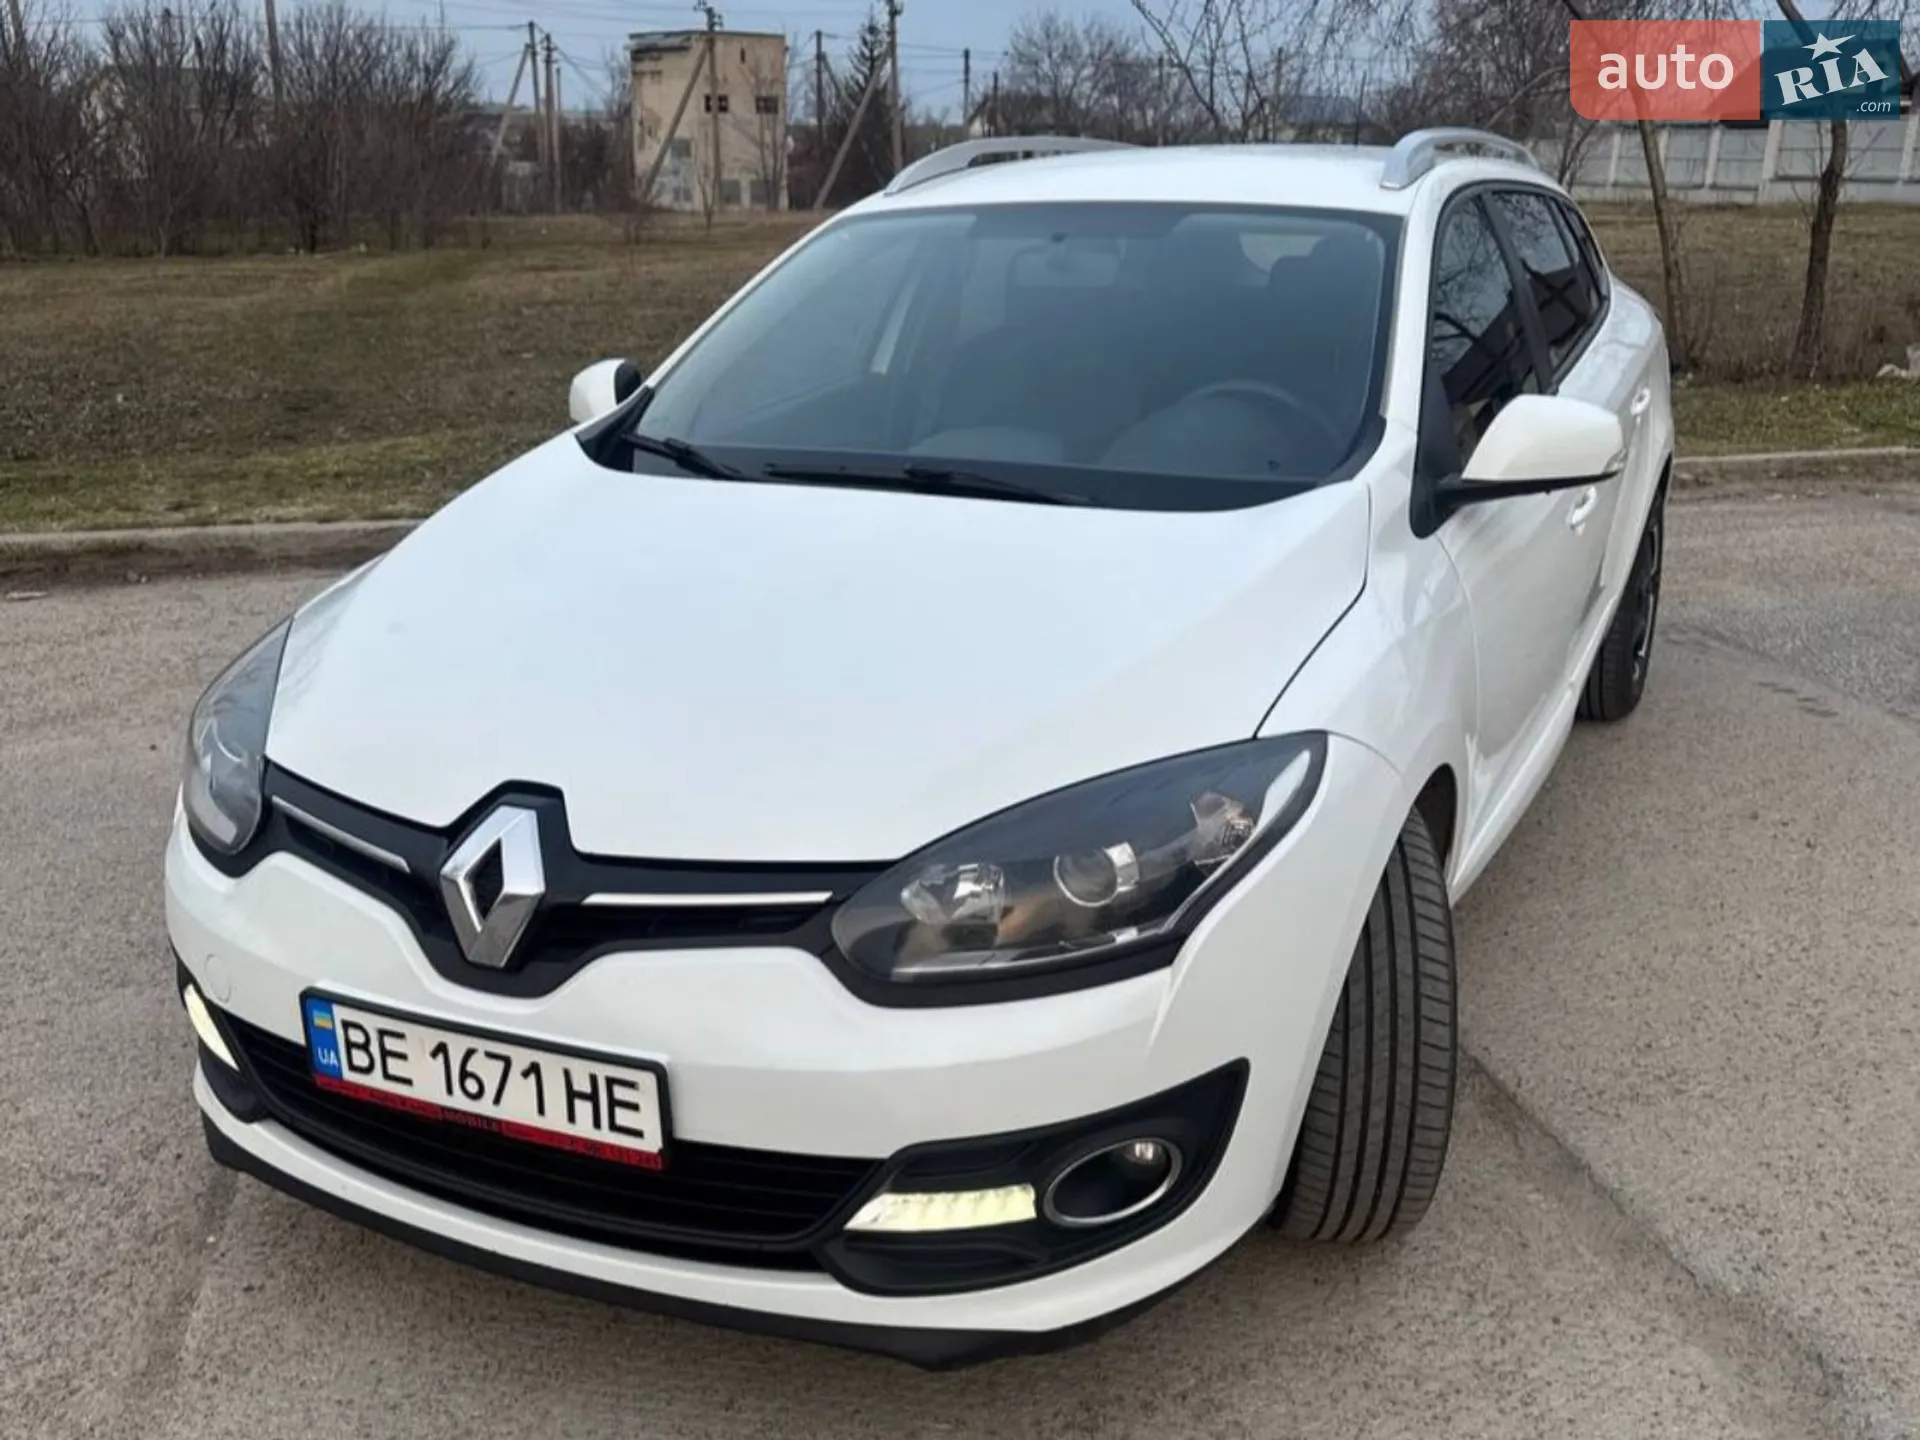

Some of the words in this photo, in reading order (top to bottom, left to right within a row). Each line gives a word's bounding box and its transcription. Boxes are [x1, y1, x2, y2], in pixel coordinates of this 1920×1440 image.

[317, 1046, 340, 1069] UA
[340, 1019, 414, 1087] BE
[429, 1041, 546, 1117] 1671
[562, 1067, 645, 1139] HE
